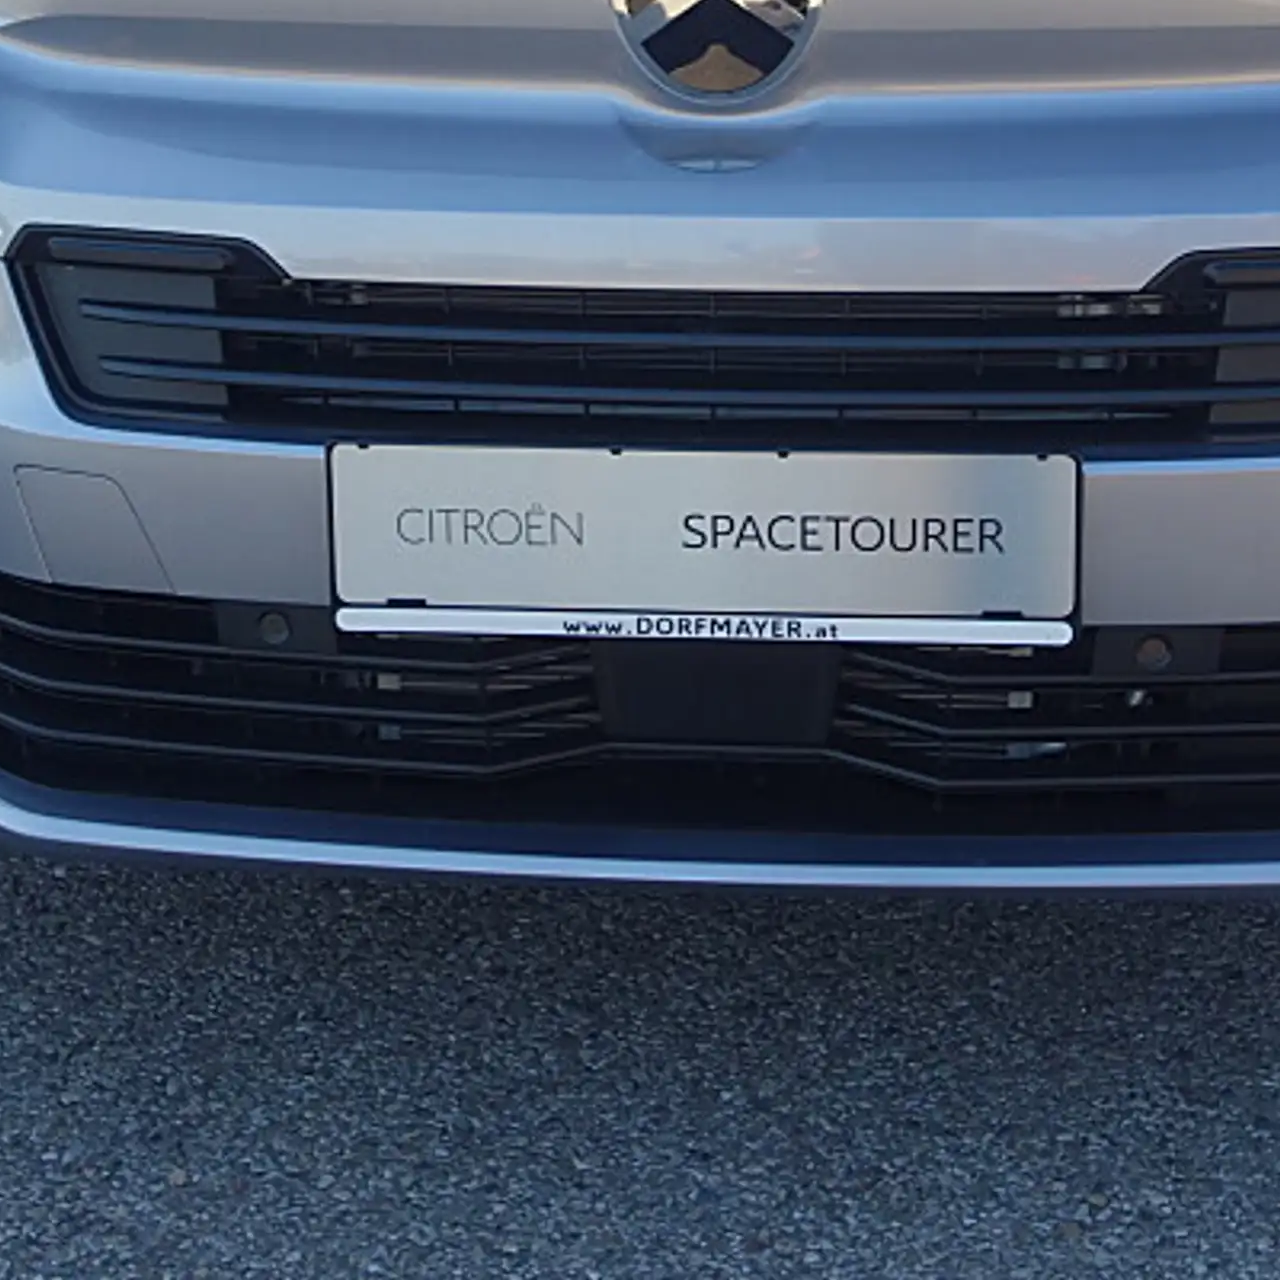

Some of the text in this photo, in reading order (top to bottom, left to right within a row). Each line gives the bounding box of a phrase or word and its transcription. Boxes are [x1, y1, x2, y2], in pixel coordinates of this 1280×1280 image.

[396, 502, 1006, 554] CITROËN SPACETOURER
[562, 616, 839, 639] www.DORFMAYER.at
